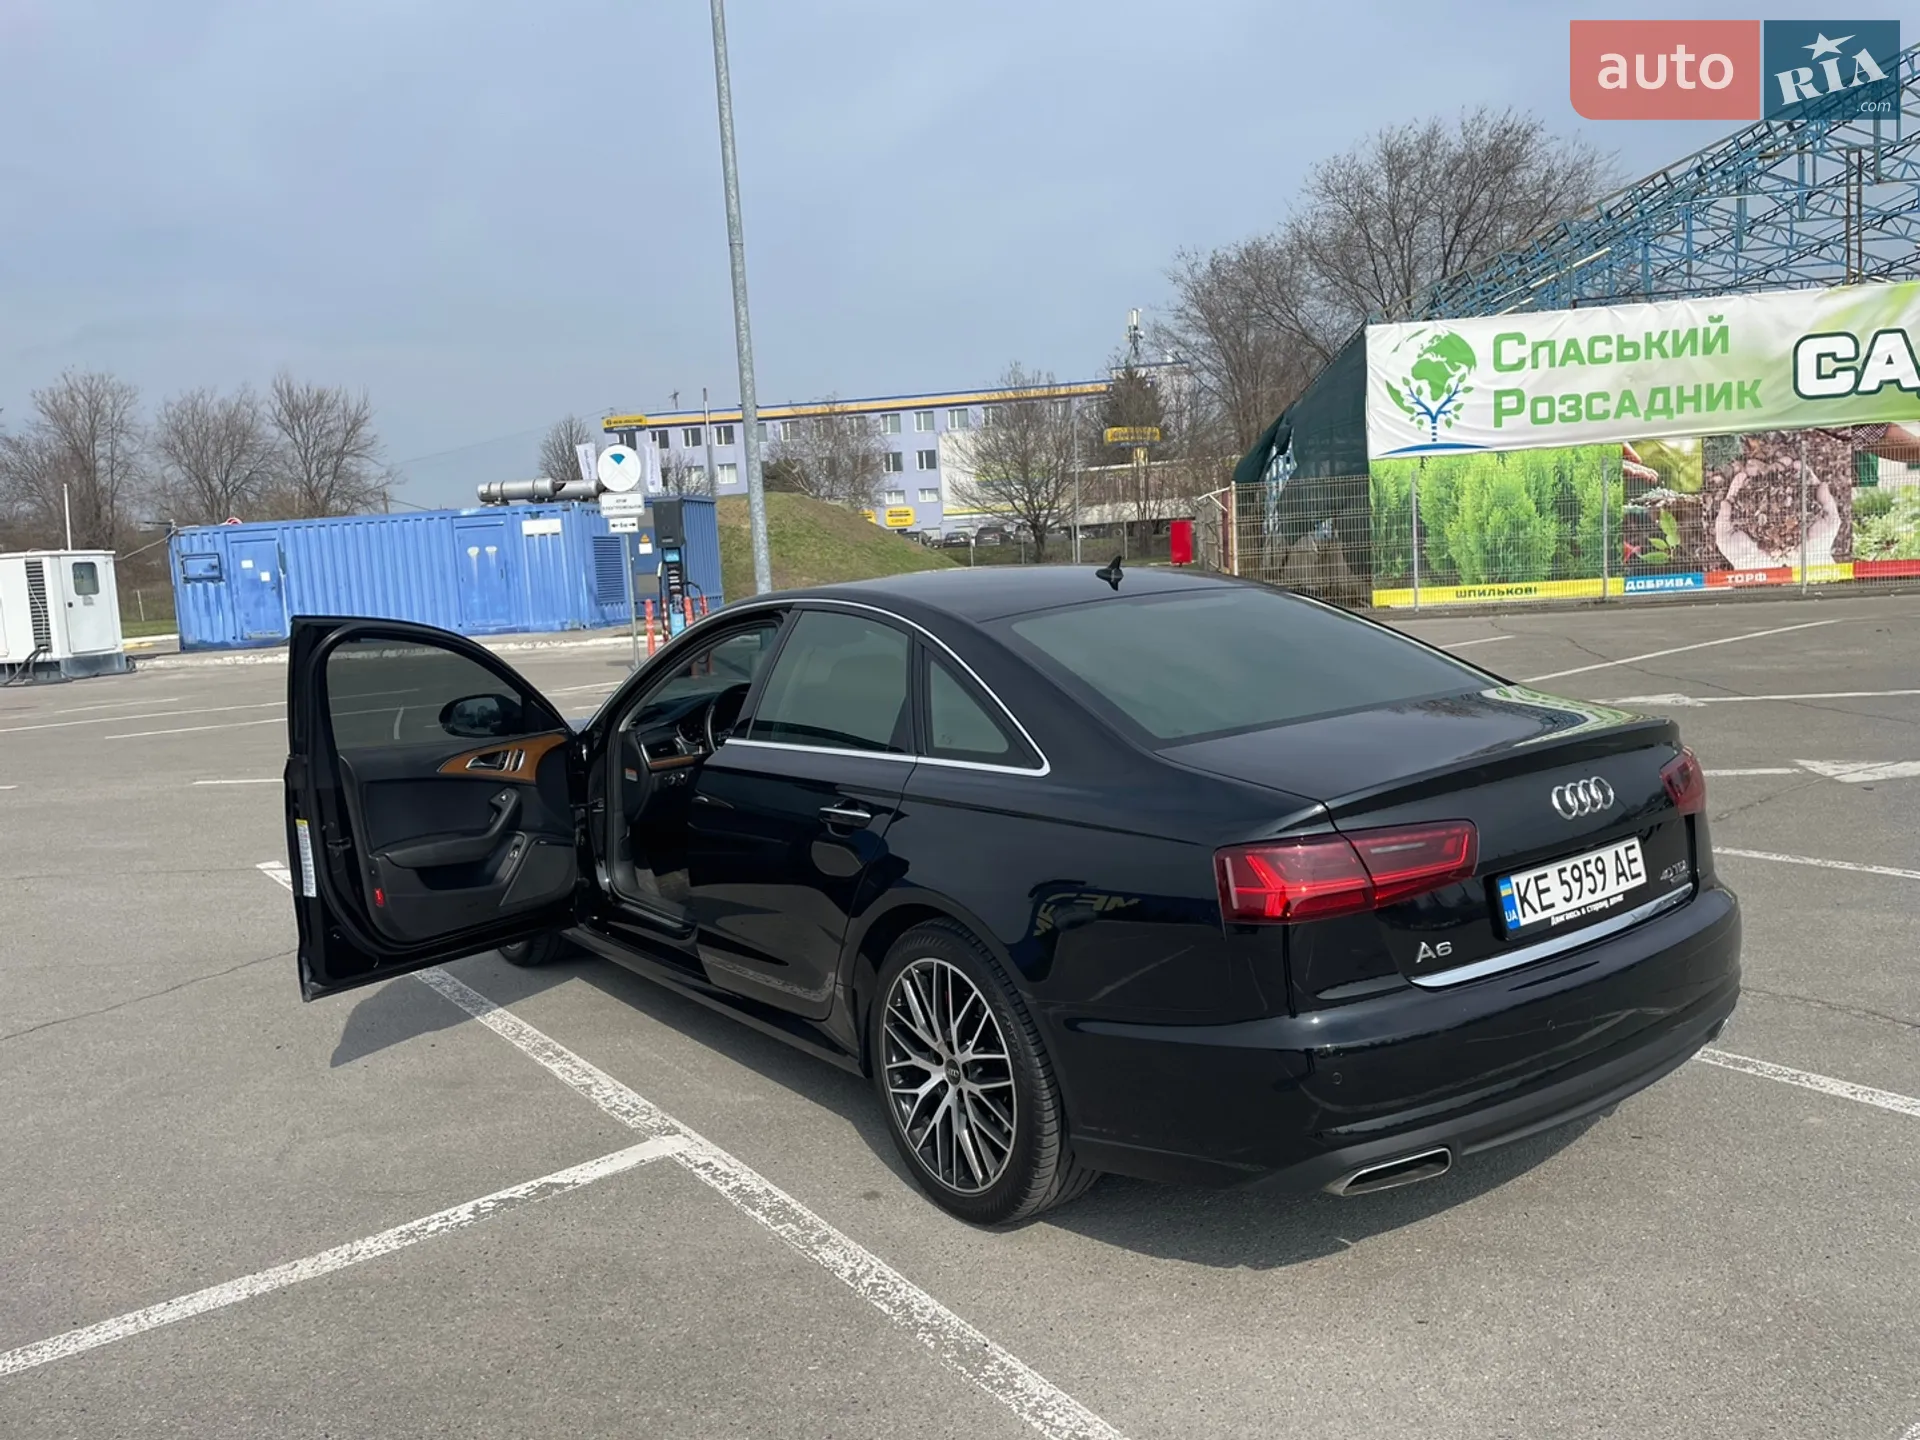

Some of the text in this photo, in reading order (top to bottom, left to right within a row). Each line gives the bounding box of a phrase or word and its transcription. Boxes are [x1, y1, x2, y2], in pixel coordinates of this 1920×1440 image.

[1793, 328, 1920, 400] СА
[1625, 577, 1695, 591] ДОБРИВА
[1726, 572, 1767, 584] ТОРФ
[1455, 586, 1537, 599] ШПИЛЬКОВІ
[1515, 844, 1642, 918] KE 5959 AE
[1505, 909, 1518, 922] UA
[1416, 941, 1452, 963] A6
